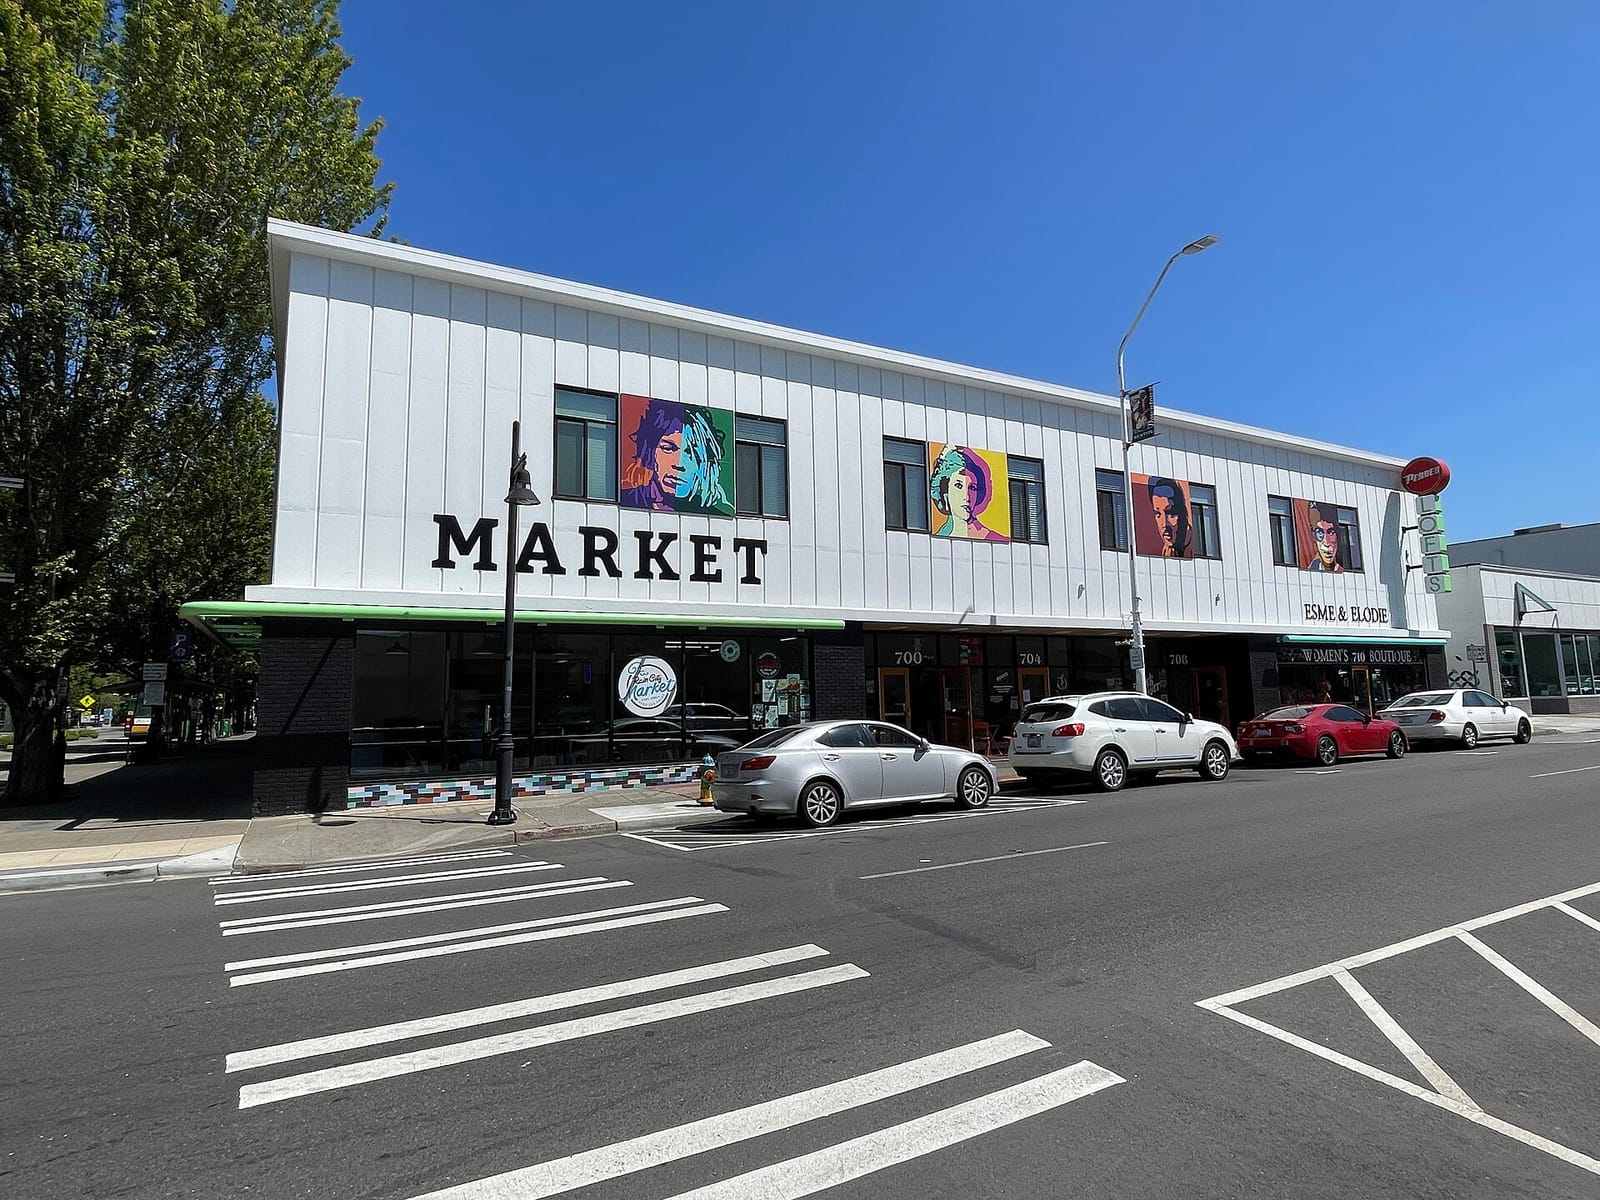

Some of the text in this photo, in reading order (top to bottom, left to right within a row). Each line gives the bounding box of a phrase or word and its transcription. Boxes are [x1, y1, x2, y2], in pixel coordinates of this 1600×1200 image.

[431, 513, 768, 585] MARKET
[1421, 497, 1441, 592] LOFTS
[1304, 604, 1389, 624] ESME & ELODIE
[894, 651, 923, 665] 700
[1019, 653, 1041, 665] 704
[1169, 654, 1188, 665] 708
[1302, 648, 1412, 664] WOMEN'S 710 BOUTIQUE
[626, 678, 675, 701] Market
